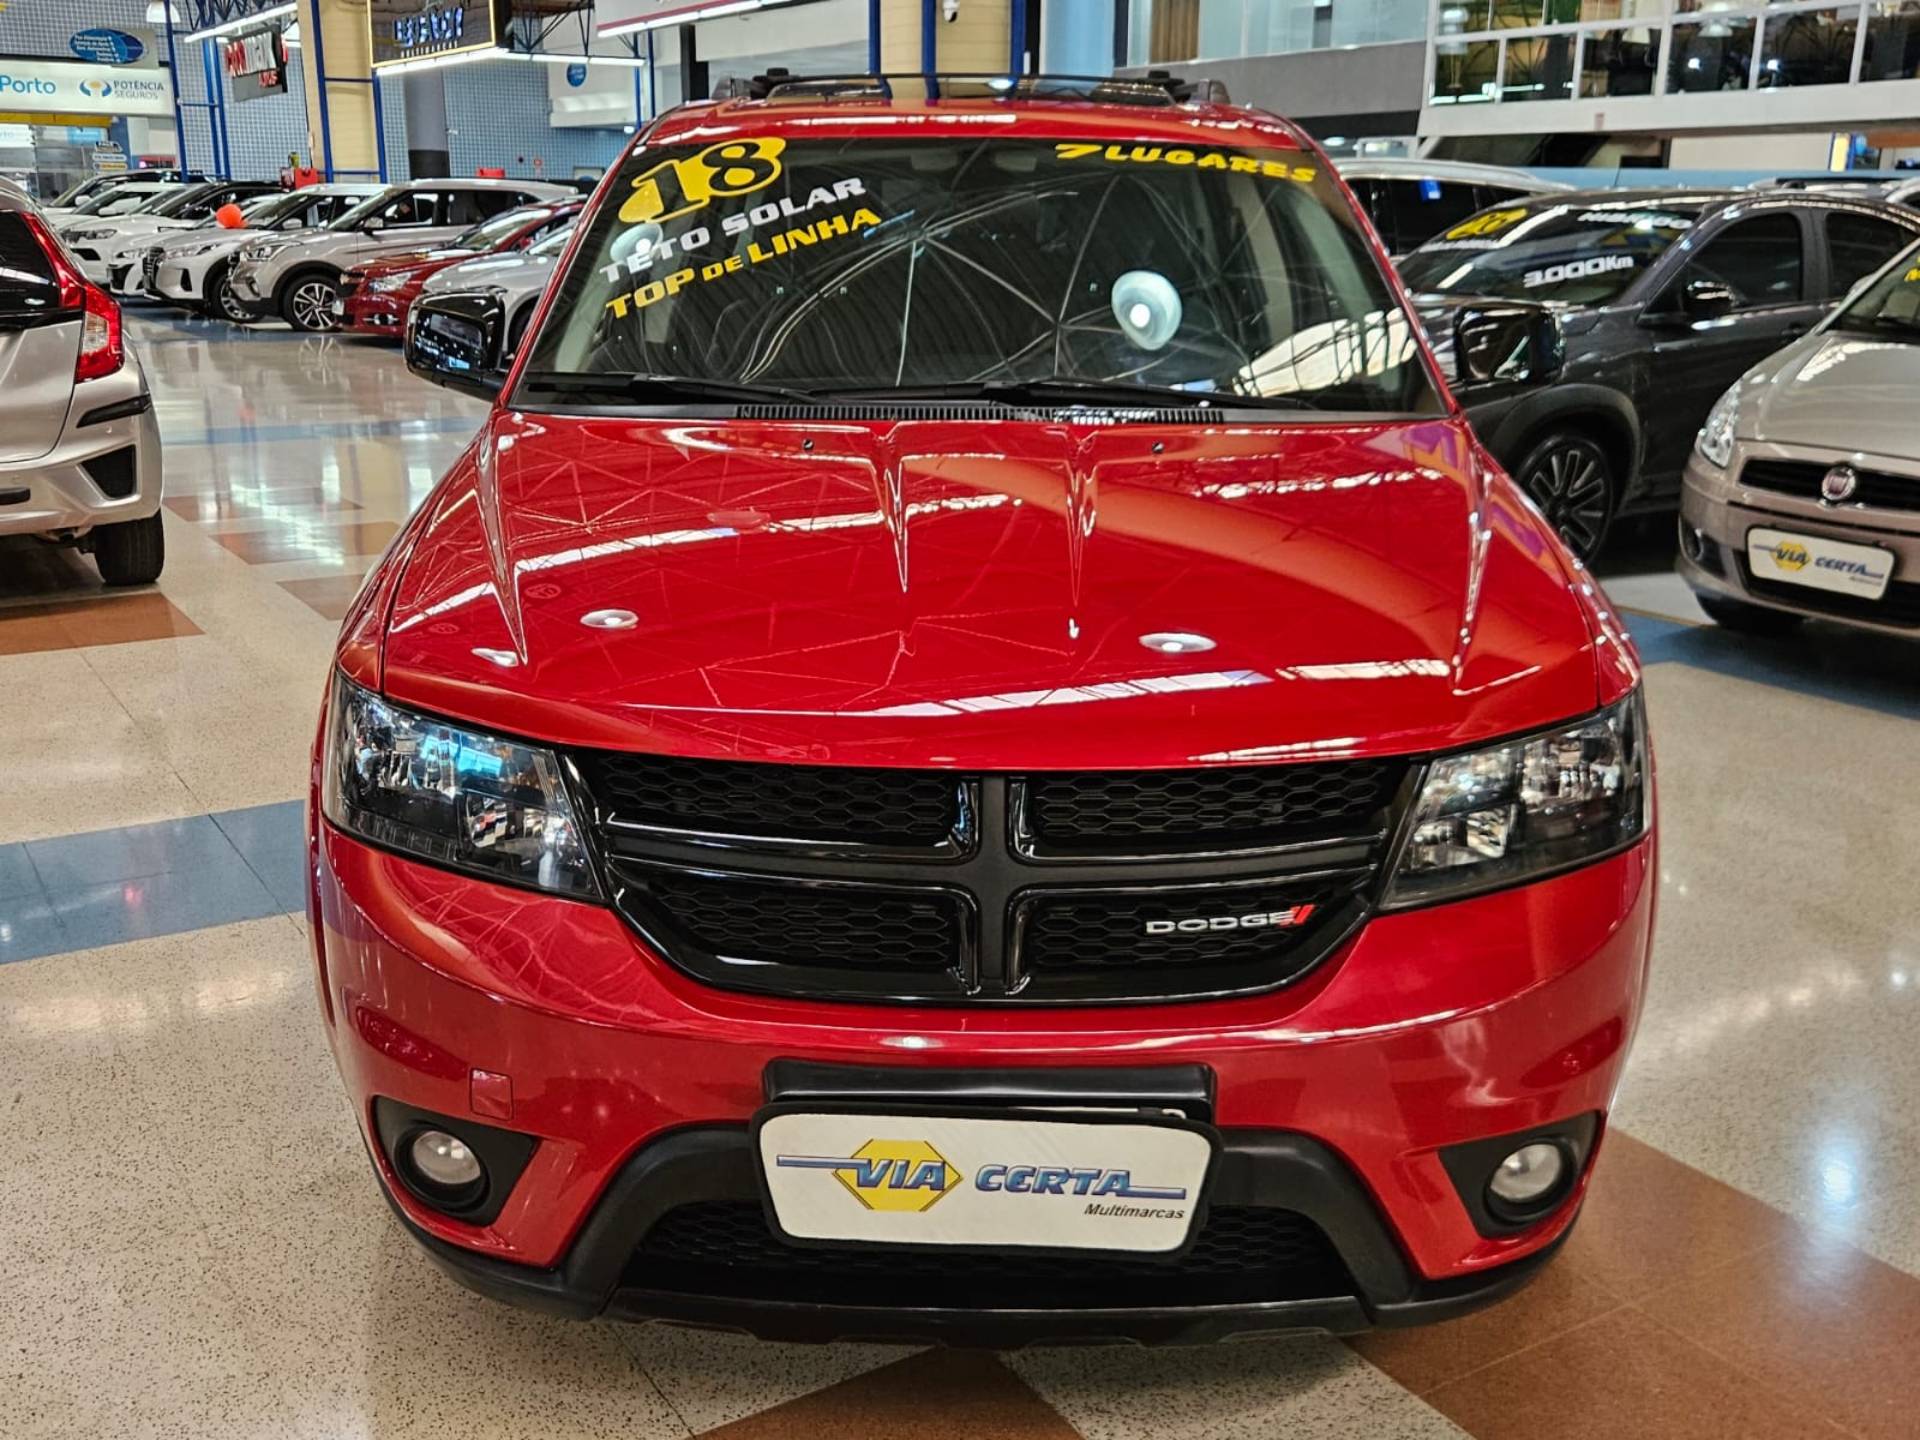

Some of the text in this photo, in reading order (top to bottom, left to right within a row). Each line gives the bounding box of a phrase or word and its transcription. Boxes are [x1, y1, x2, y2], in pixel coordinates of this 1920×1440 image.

[0, 75, 56, 94] Porto
[618, 136, 786, 222] 18
[1055, 143, 1317, 182] 7 LUGARES
[599, 177, 867, 283] TETO SOLAR
[605, 207, 882, 319] TOP DE LINHA
[1776, 548, 1807, 562] VIA
[1145, 909, 1297, 934] DODGE
[854, 1157, 1133, 1196] VIA CERTA
[1083, 1202, 1186, 1220] Multimarcas
